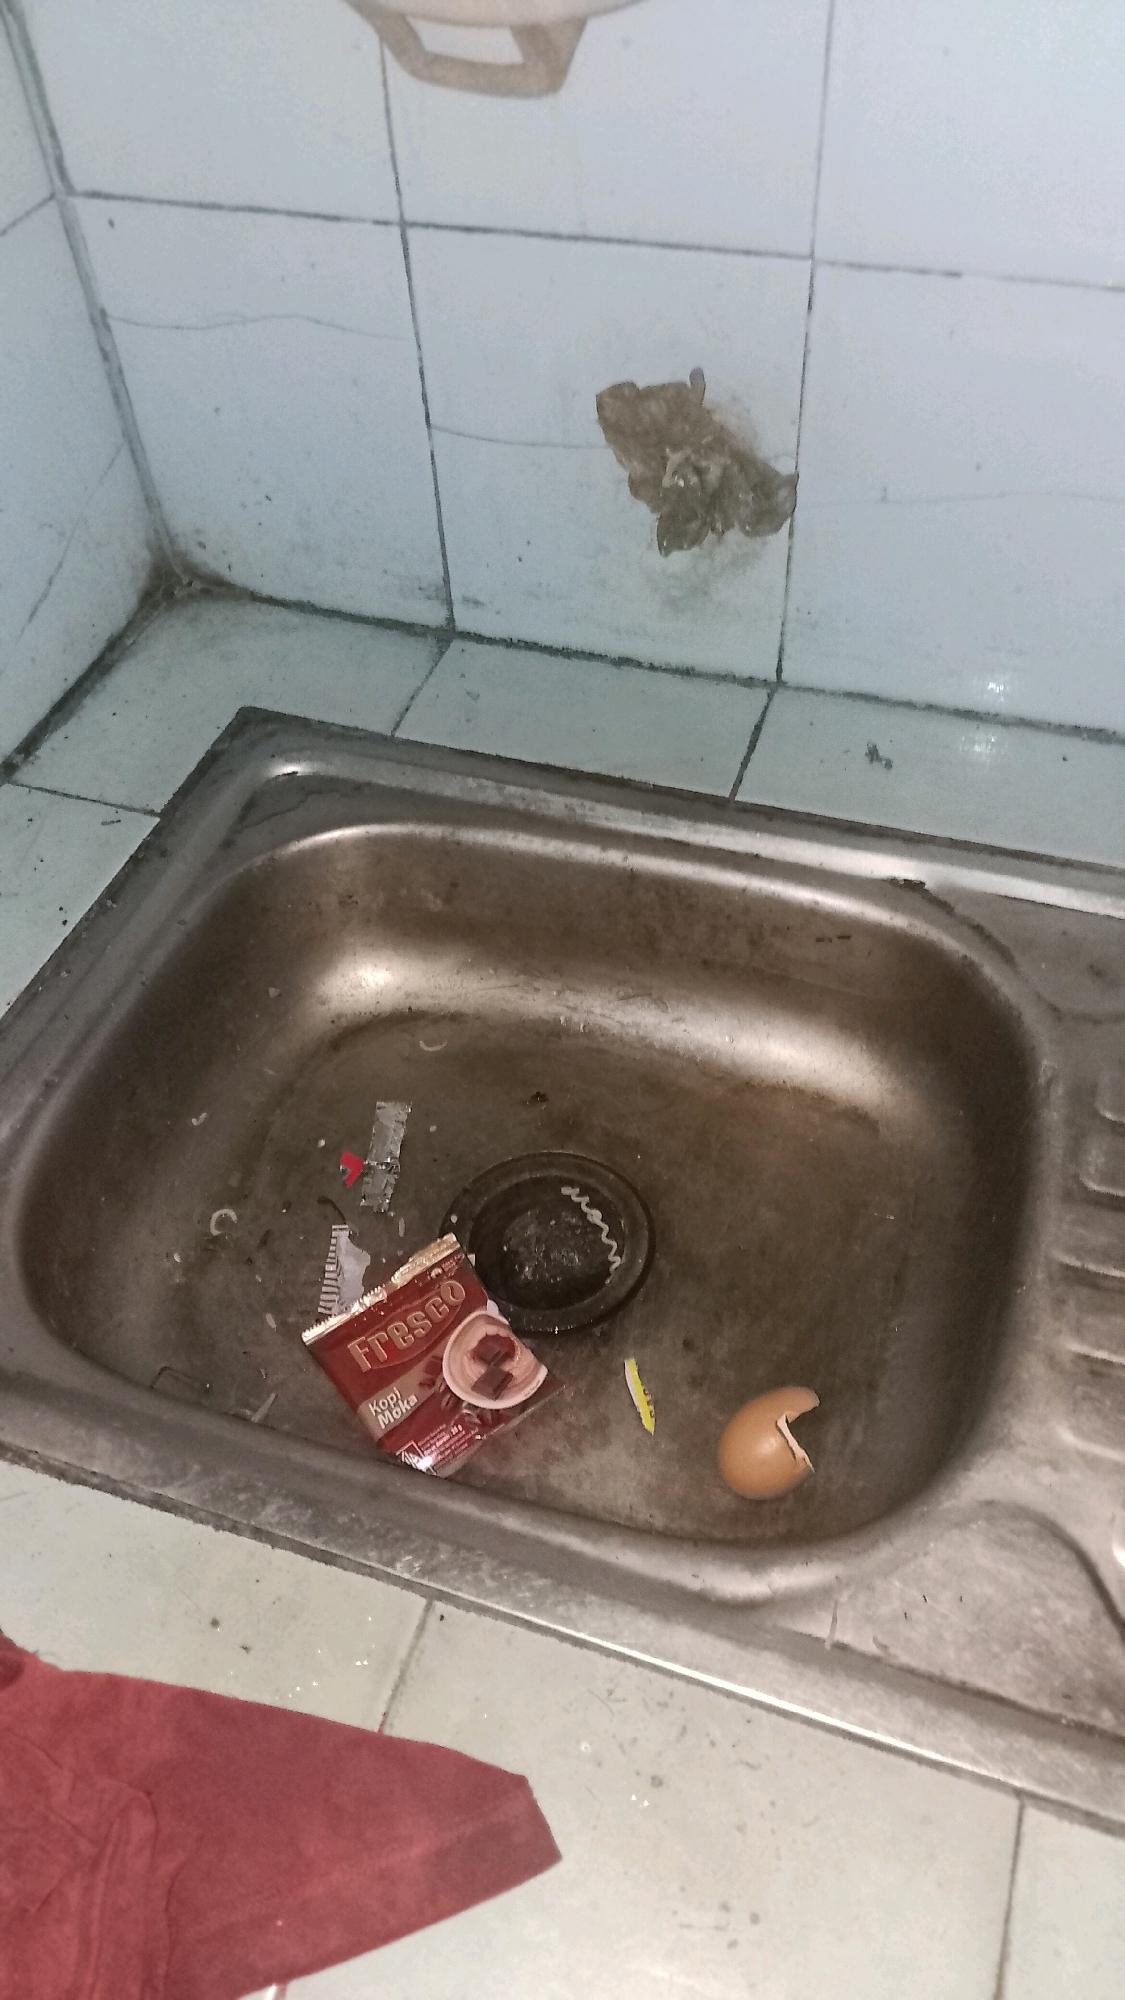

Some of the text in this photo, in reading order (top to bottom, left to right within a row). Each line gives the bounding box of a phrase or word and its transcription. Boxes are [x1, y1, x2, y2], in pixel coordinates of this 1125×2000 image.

[347, 1280, 466, 1373] Fresco
[368, 1386, 401, 1417] Kopi
[377, 1394, 418, 1430] Moka
